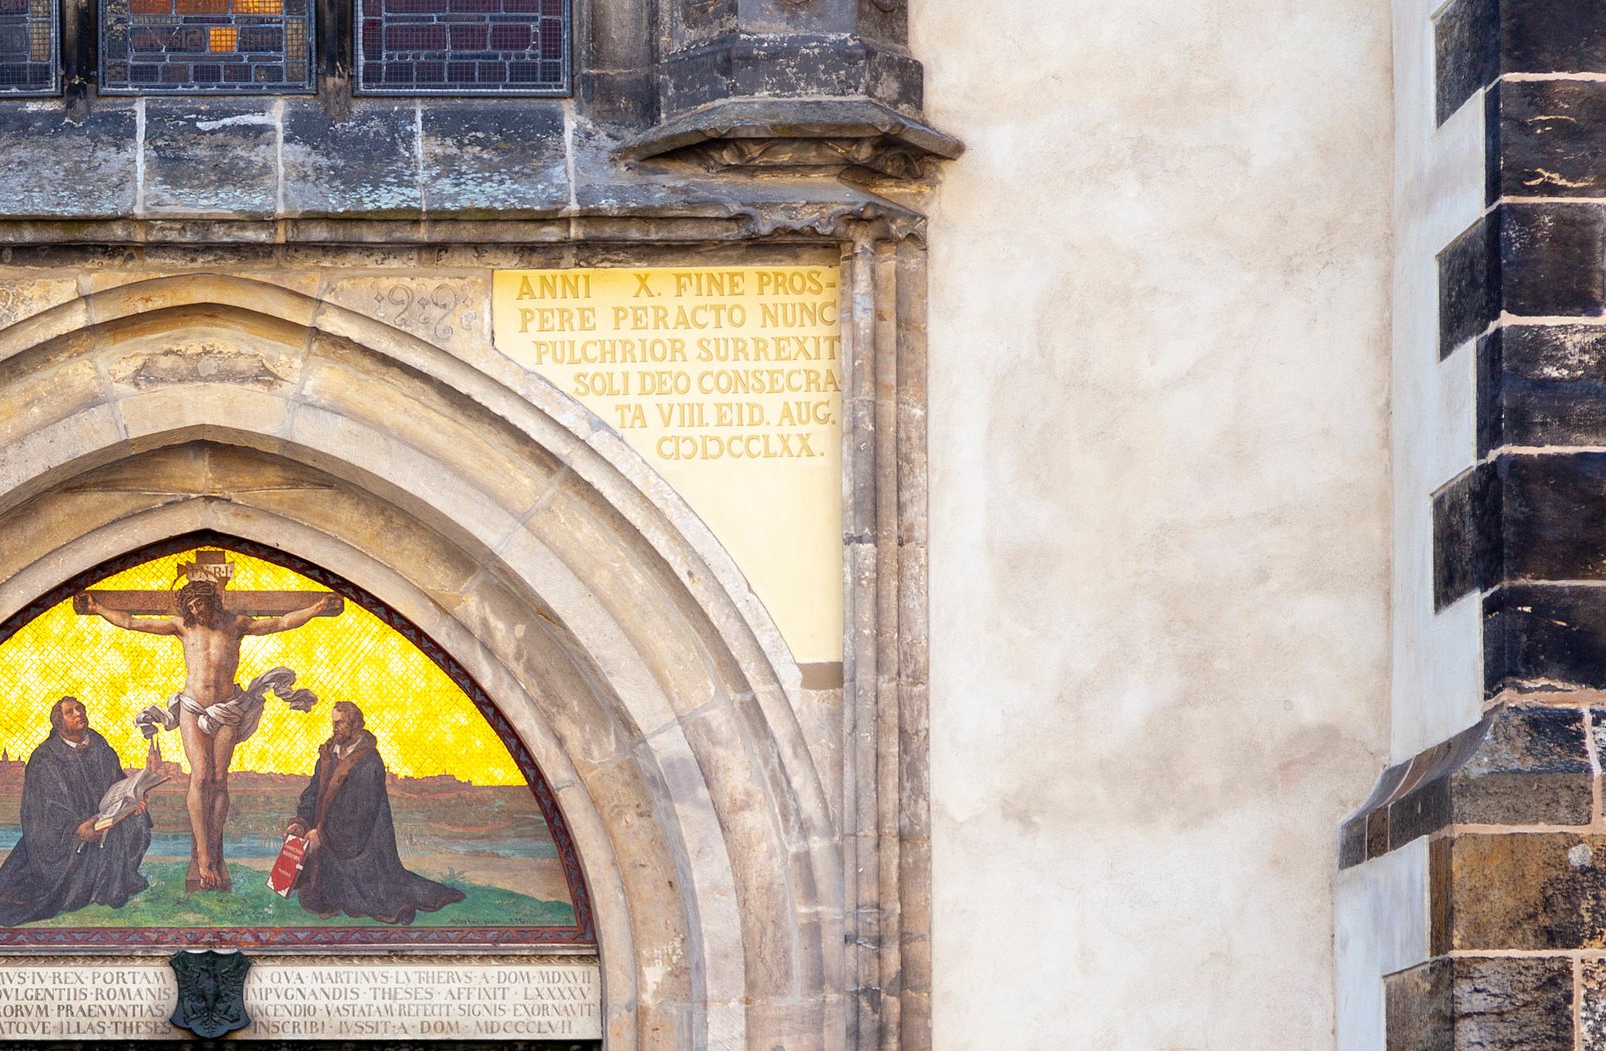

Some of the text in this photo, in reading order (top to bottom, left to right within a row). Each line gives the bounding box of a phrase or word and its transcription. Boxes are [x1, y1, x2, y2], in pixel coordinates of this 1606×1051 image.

[516, 270, 836, 300] ANNI X. FINE PROS-
[518, 299, 837, 333] PERE PERACTO NUNC
[532, 335, 841, 365] PULCHRIOR SURREXIT
[573, 369, 842, 396] SOLI DEO CONSECRA
[615, 403, 647, 428] TA
[777, 400, 837, 427] AUG.
[52, 971, 85, 985] REX
[91, 971, 167, 985] PORTAM
[270, 971, 305, 984] QVA
[311, 971, 389, 984] MARTINVS
[395, 971, 473, 984] LVTHERVS
[497, 971, 531, 984] DOM
[538, 971, 591, 984] MDXVII
[95, 988, 171, 1001] ROMANIS
[244, 987, 591, 1000] IMPVGNANDIS THESES AFFIXIT LXXXXV
[57, 1004, 165, 1018] PRAENVNTIAS
[250, 1004, 596, 1017] INCENDIO VASTATAM REFECIT SIGNIS EXORNAVIT
[60, 1021, 106, 1035] ILLAS
[110, 1021, 172, 1035] THESES
[254, 1021, 325, 1034] INSCRIBI
[339, 1021, 391, 1034] IVSSIT
[420, 1021, 461, 1034] DOM
